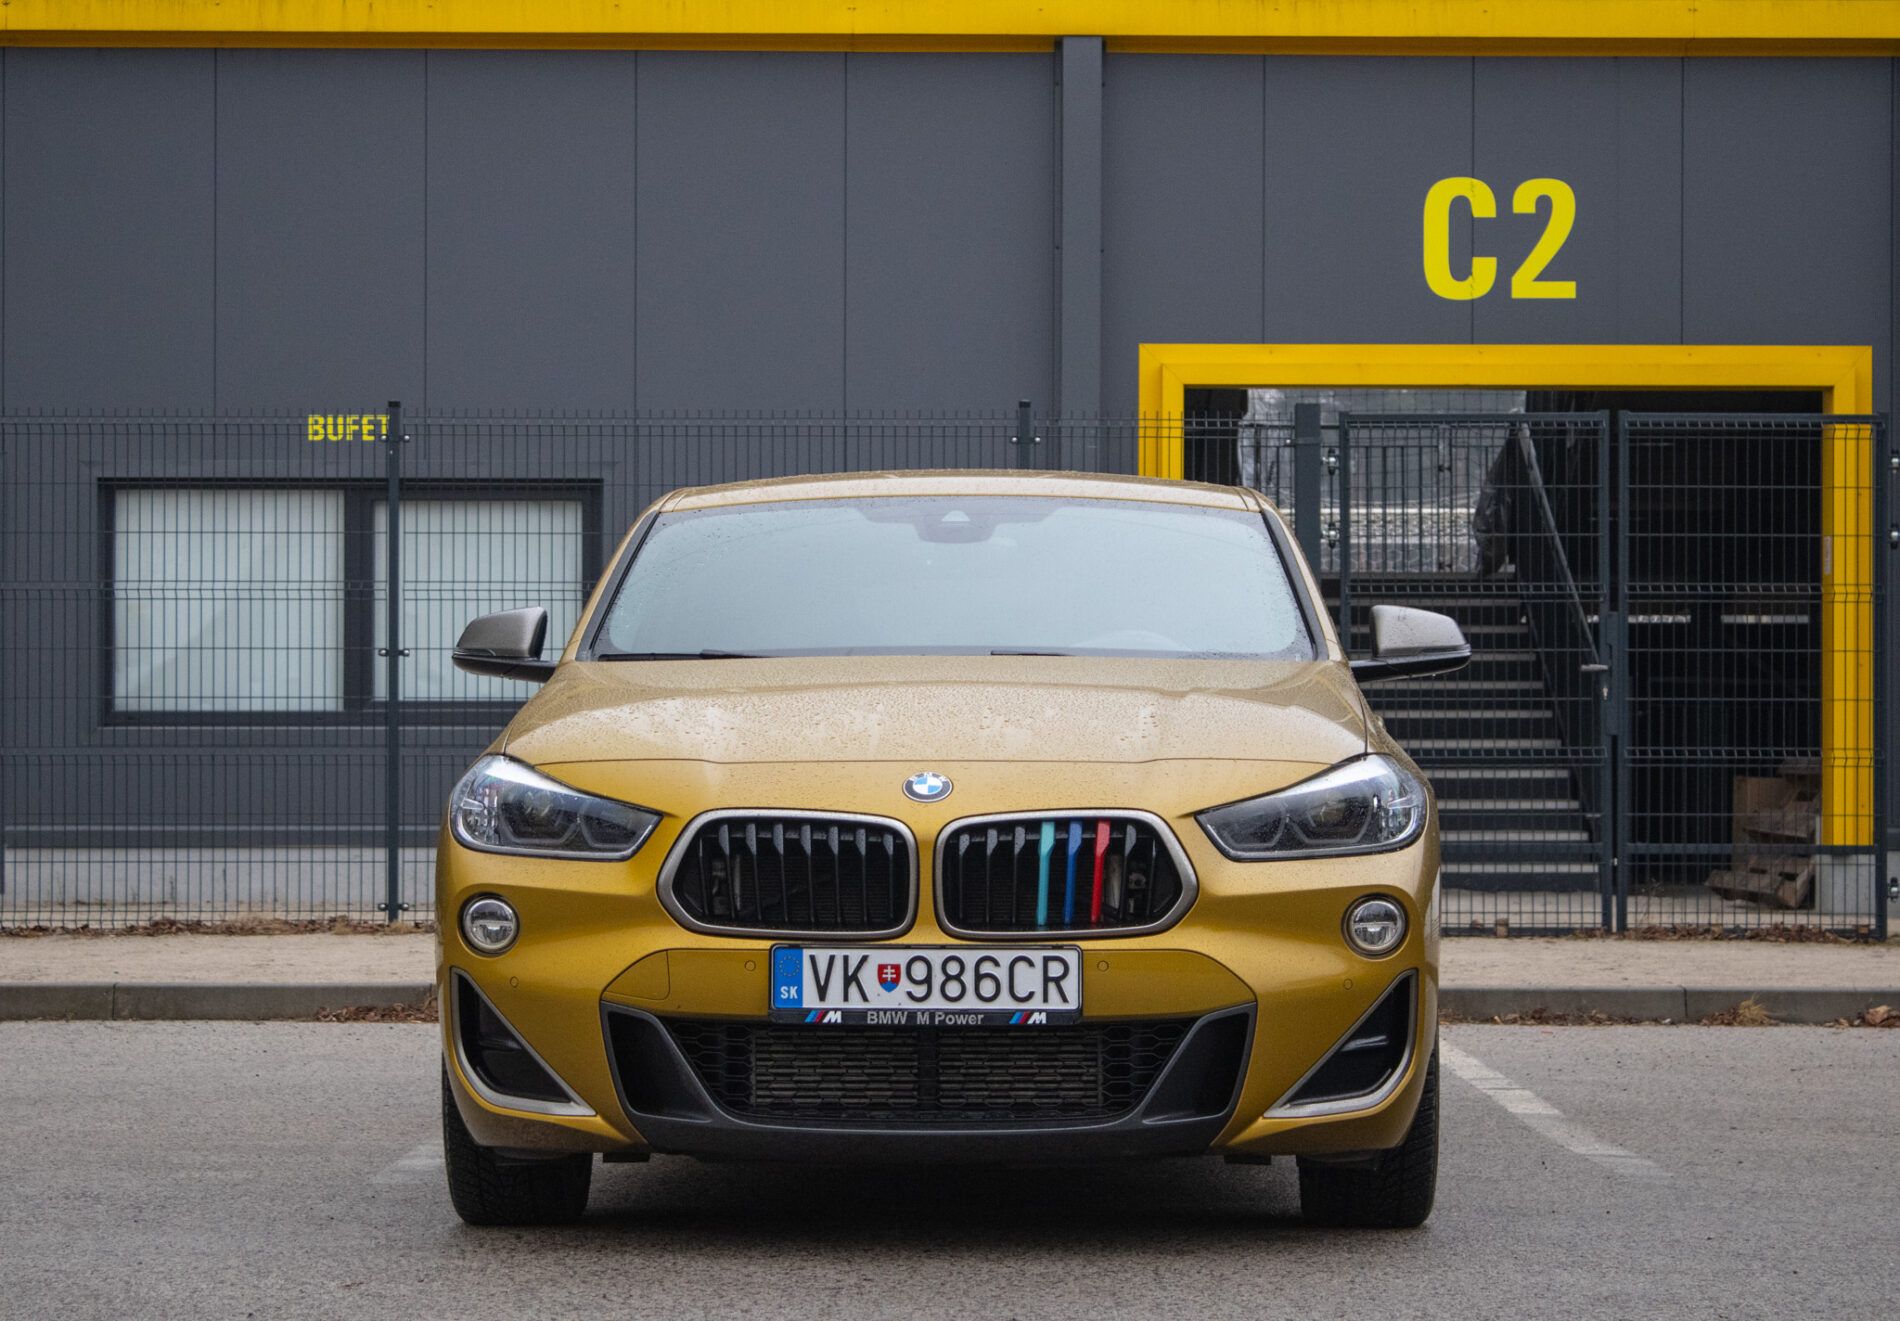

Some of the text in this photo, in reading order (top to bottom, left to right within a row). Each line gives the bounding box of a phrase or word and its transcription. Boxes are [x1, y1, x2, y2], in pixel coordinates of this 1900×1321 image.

[1423, 176, 1577, 301] C2
[307, 414, 389, 441] BUFET
[780, 985, 798, 999] SK
[808, 954, 1069, 1004] VK 986CR
[866, 1010, 984, 1025] BMW M Power
